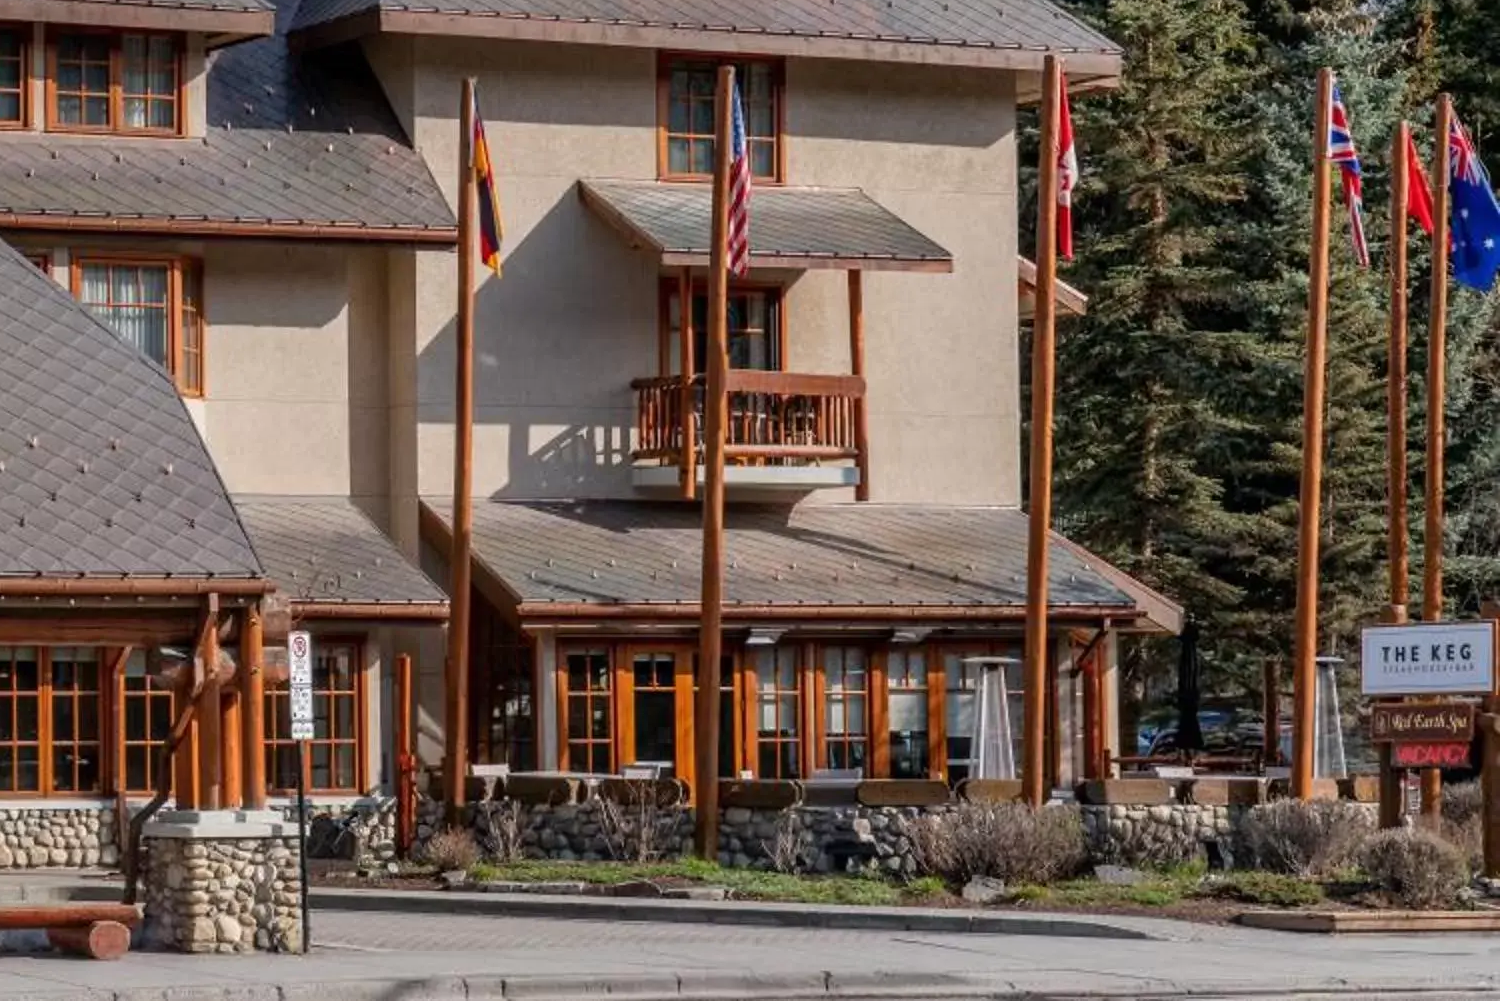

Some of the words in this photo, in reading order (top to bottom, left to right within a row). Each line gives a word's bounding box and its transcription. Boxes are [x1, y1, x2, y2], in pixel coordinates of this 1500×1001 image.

[1381, 646, 1420, 663] THE
[1431, 643, 1472, 661] KEG
[1413, 711, 1445, 728] Earth
[1446, 712, 1468, 734] Spa
